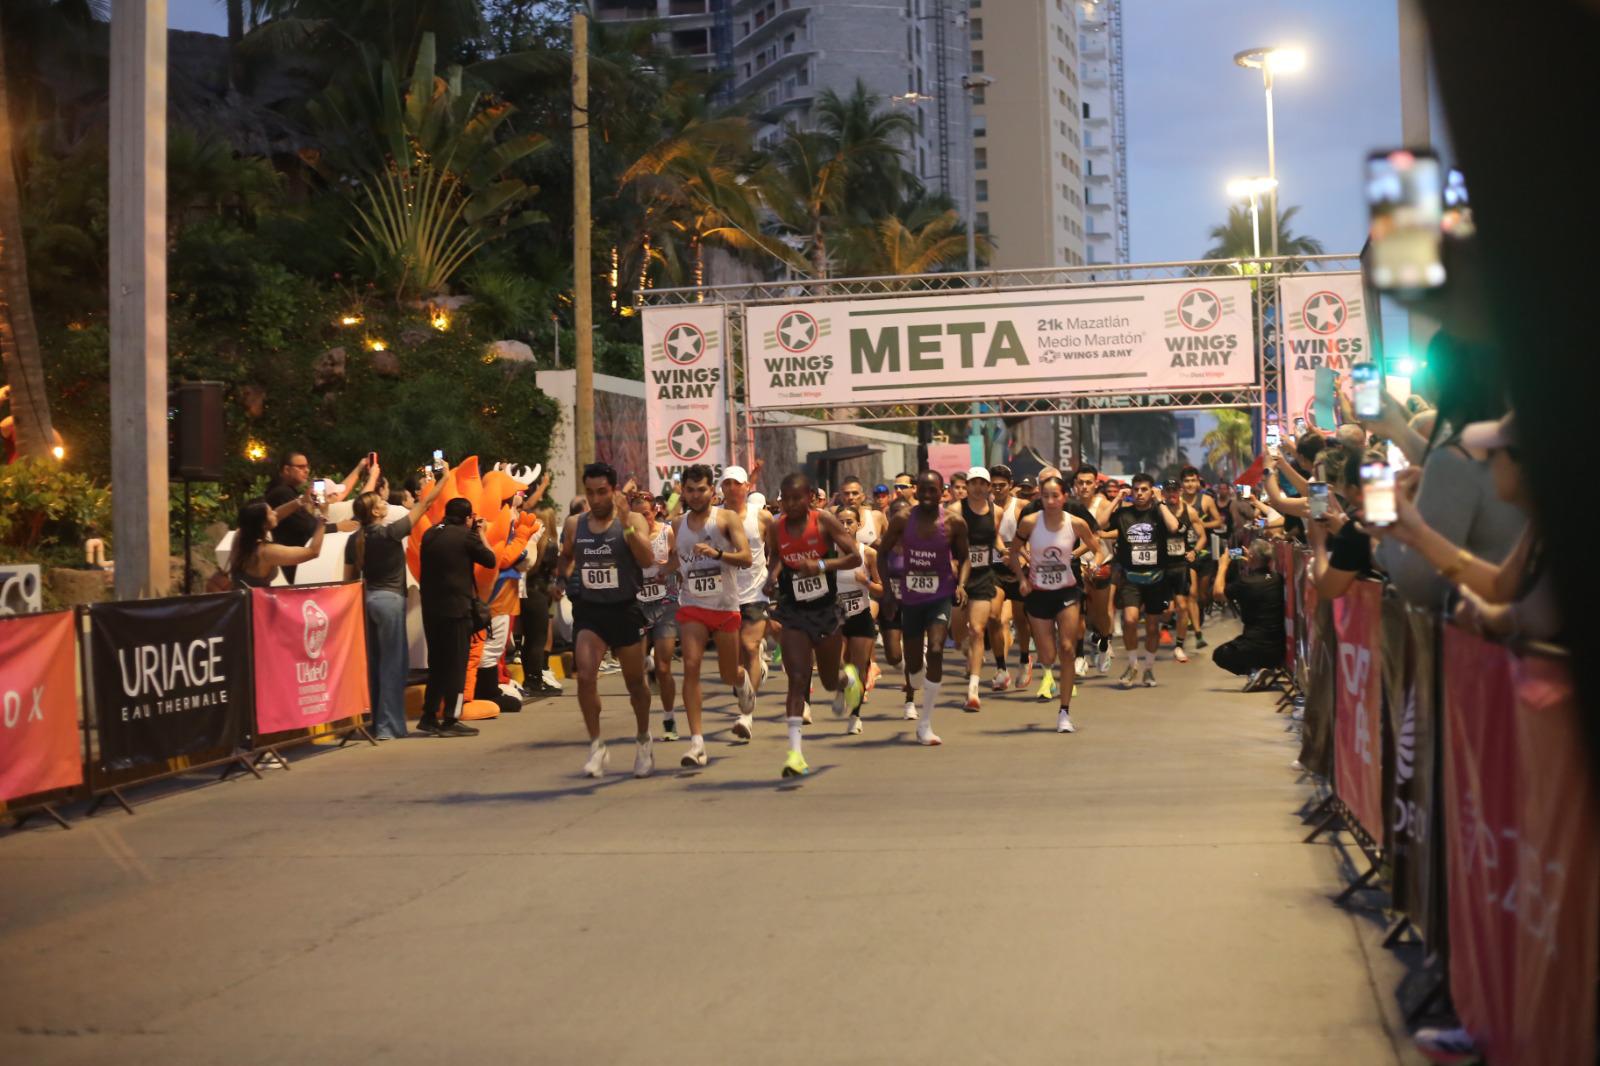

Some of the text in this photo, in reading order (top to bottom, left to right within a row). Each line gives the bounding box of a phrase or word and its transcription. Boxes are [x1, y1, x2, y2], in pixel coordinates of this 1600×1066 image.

[1037, 315, 1130, 331] 21k Mazatlán
[849, 320, 1030, 374] META
[1038, 331, 1142, 348] Medio Maratón
[1102, 349, 1132, 359] ARMY
[1170, 350, 1232, 367] ARMY
[1294, 354, 1357, 370] ARMY
[769, 371, 829, 388] ARMY
[657, 383, 716, 399] ARMY
[783, 549, 820, 561] KENYA
[1138, 551, 1151, 561] 49
[588, 569, 612, 584] 601
[694, 577, 716, 592] 473
[911, 576, 934, 589] 283
[640, 584, 660, 598] 470
[797, 577, 822, 594] 469
[118, 636, 225, 697] URIAGE
[121, 690, 228, 721] EAU THERMALE
